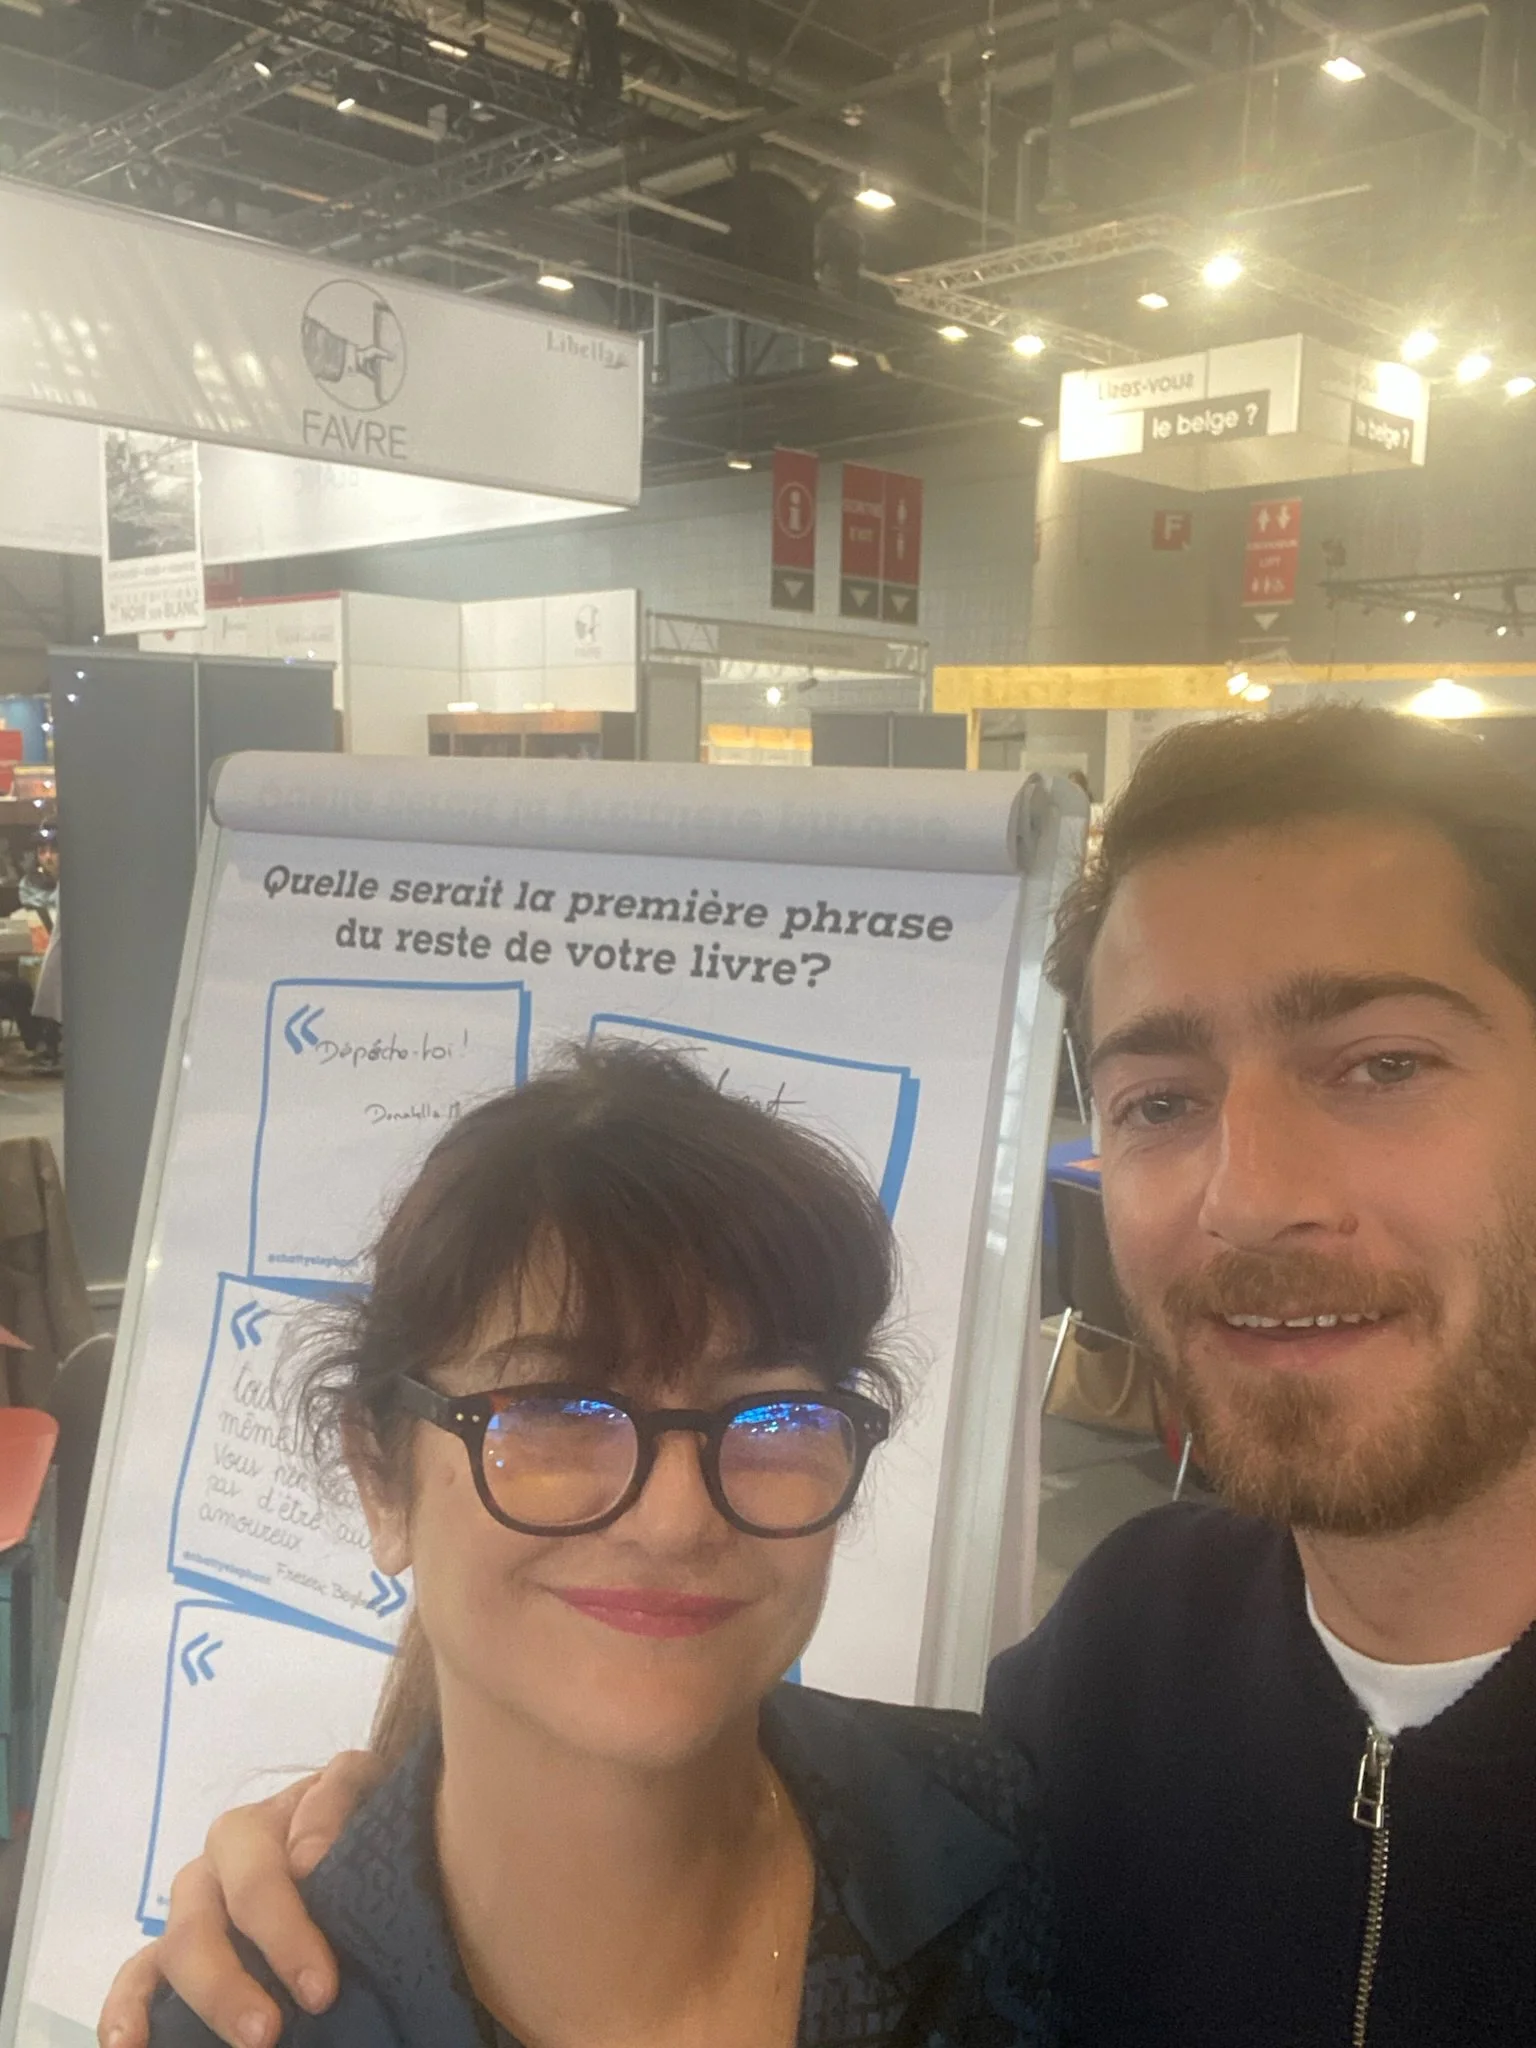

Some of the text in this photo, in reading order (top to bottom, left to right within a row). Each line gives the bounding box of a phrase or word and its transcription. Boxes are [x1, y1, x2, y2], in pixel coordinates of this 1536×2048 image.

[302, 409, 408, 460] FAVRE
[1152, 402, 1259, 440] le belge ?
[1164, 514, 1184, 541] F
[263, 864, 954, 942] Quelle serait la première phrase
[335, 917, 832, 988] du reste de votre livre?
